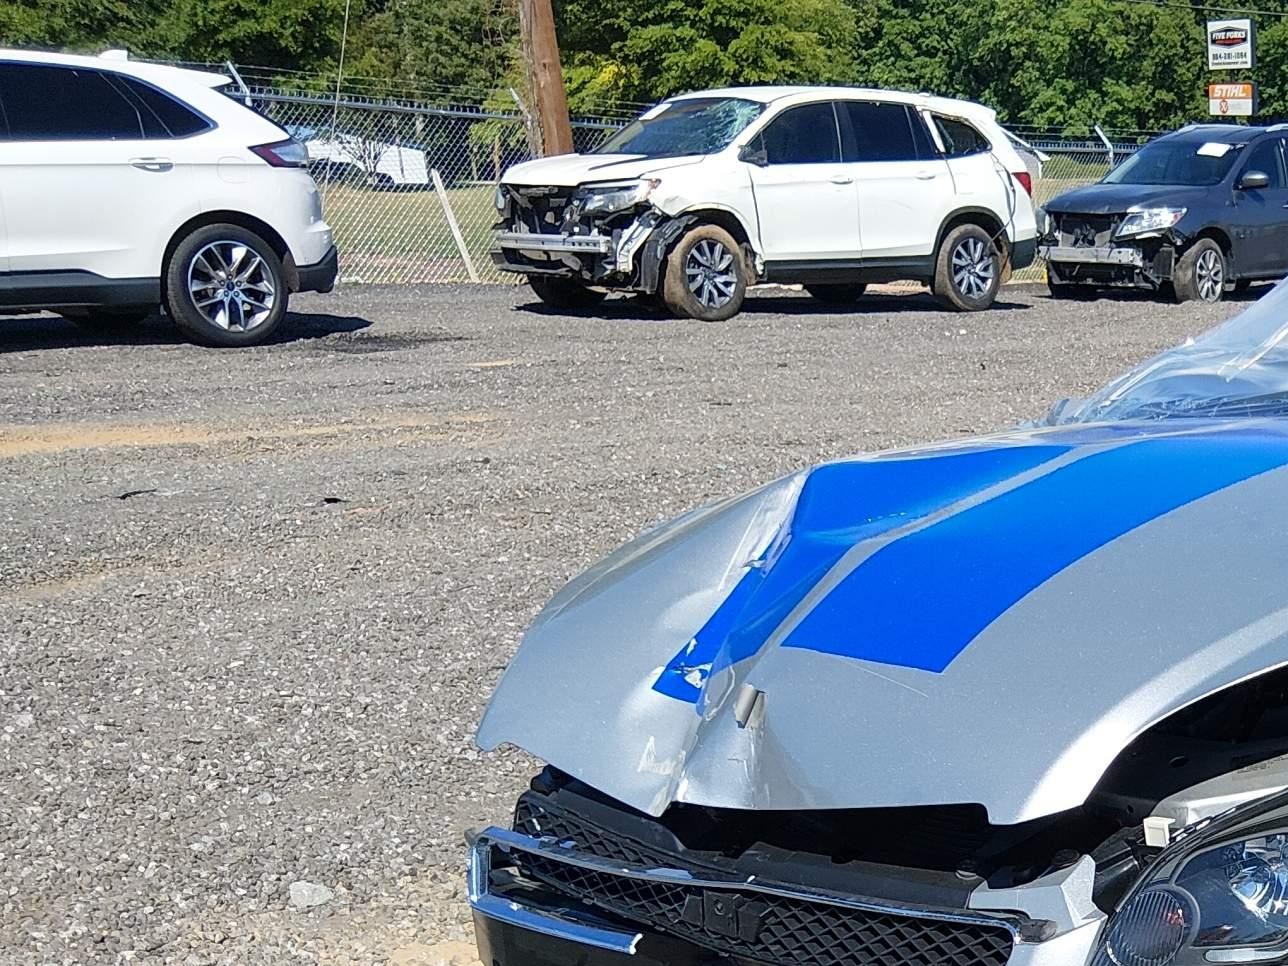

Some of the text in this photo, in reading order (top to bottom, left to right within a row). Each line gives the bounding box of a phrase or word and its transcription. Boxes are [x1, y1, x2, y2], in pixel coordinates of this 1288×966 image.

[1212, 30, 1246, 40] FIVE FORKS
[1213, 85, 1246, 97] STIHL
